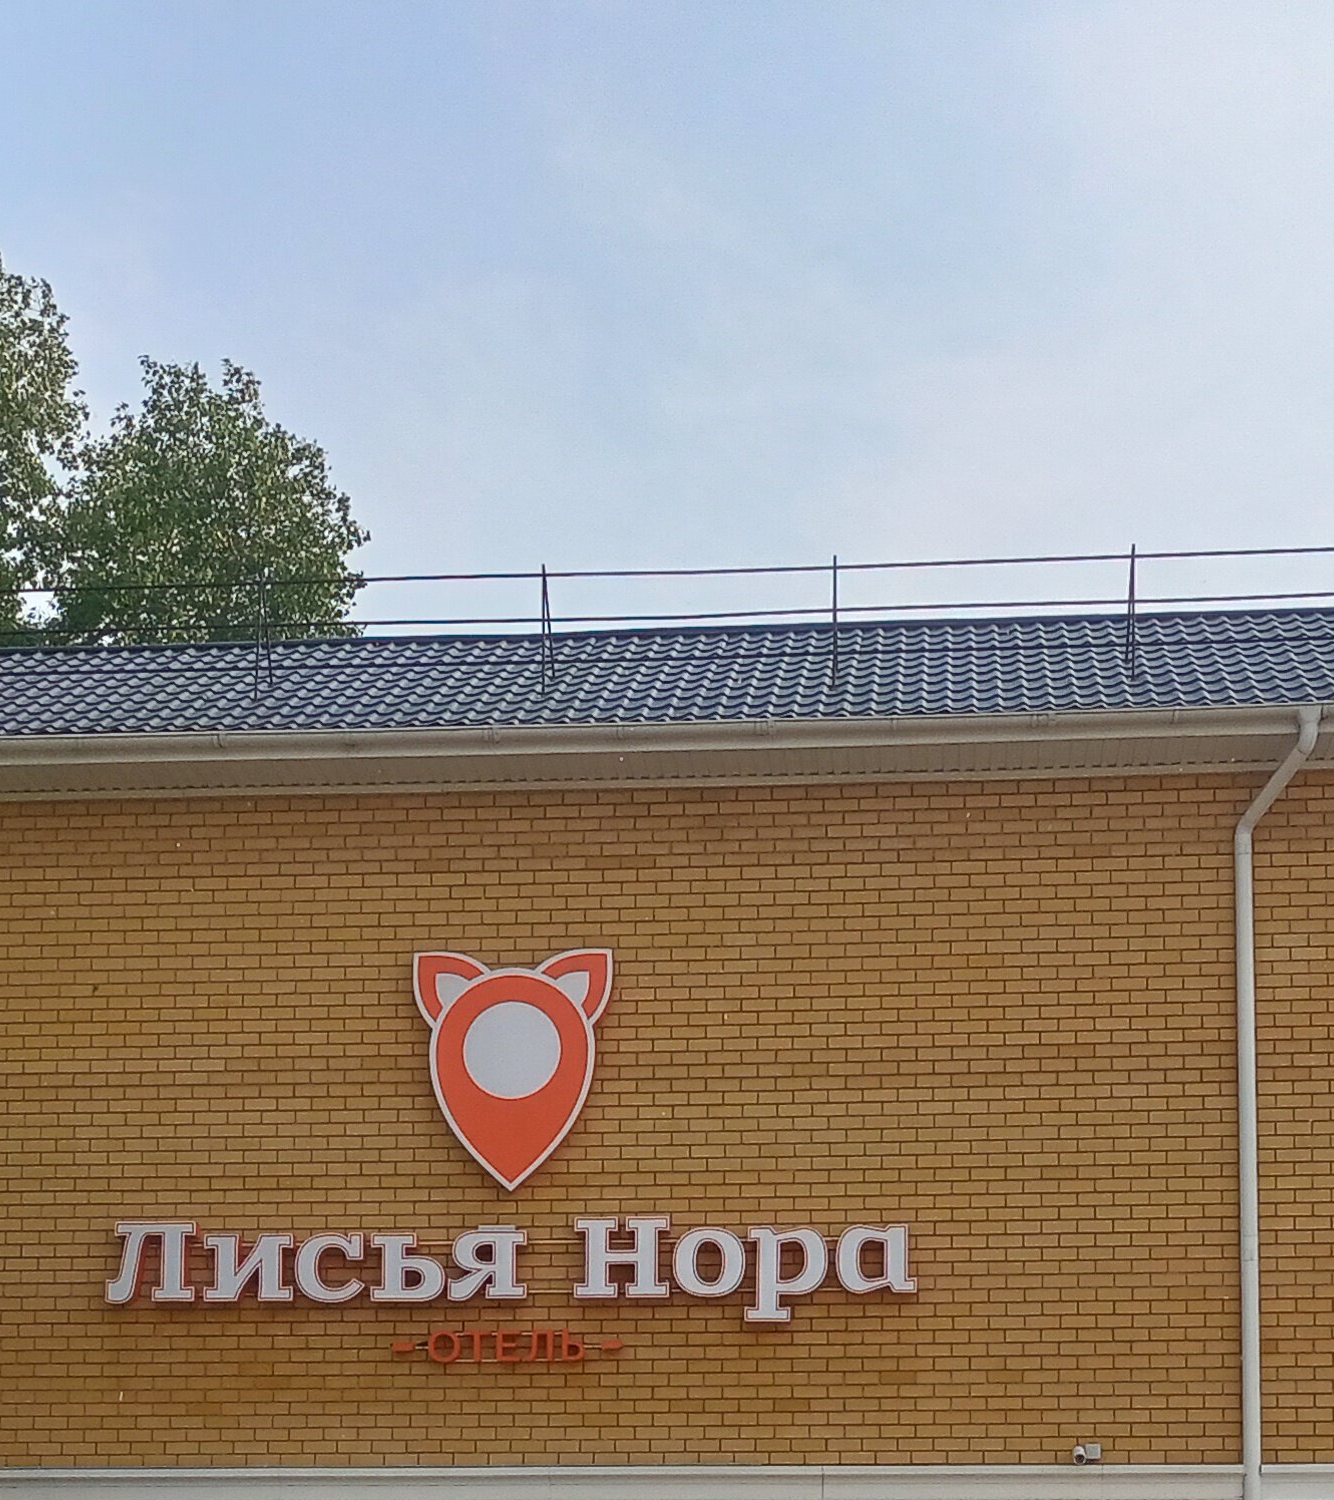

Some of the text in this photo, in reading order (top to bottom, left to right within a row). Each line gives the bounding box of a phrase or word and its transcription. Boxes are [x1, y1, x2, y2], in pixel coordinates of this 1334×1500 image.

[105, 1216, 918, 1322] Лисья Нора
[428, 1328, 586, 1363] ОТЕЛЬ
